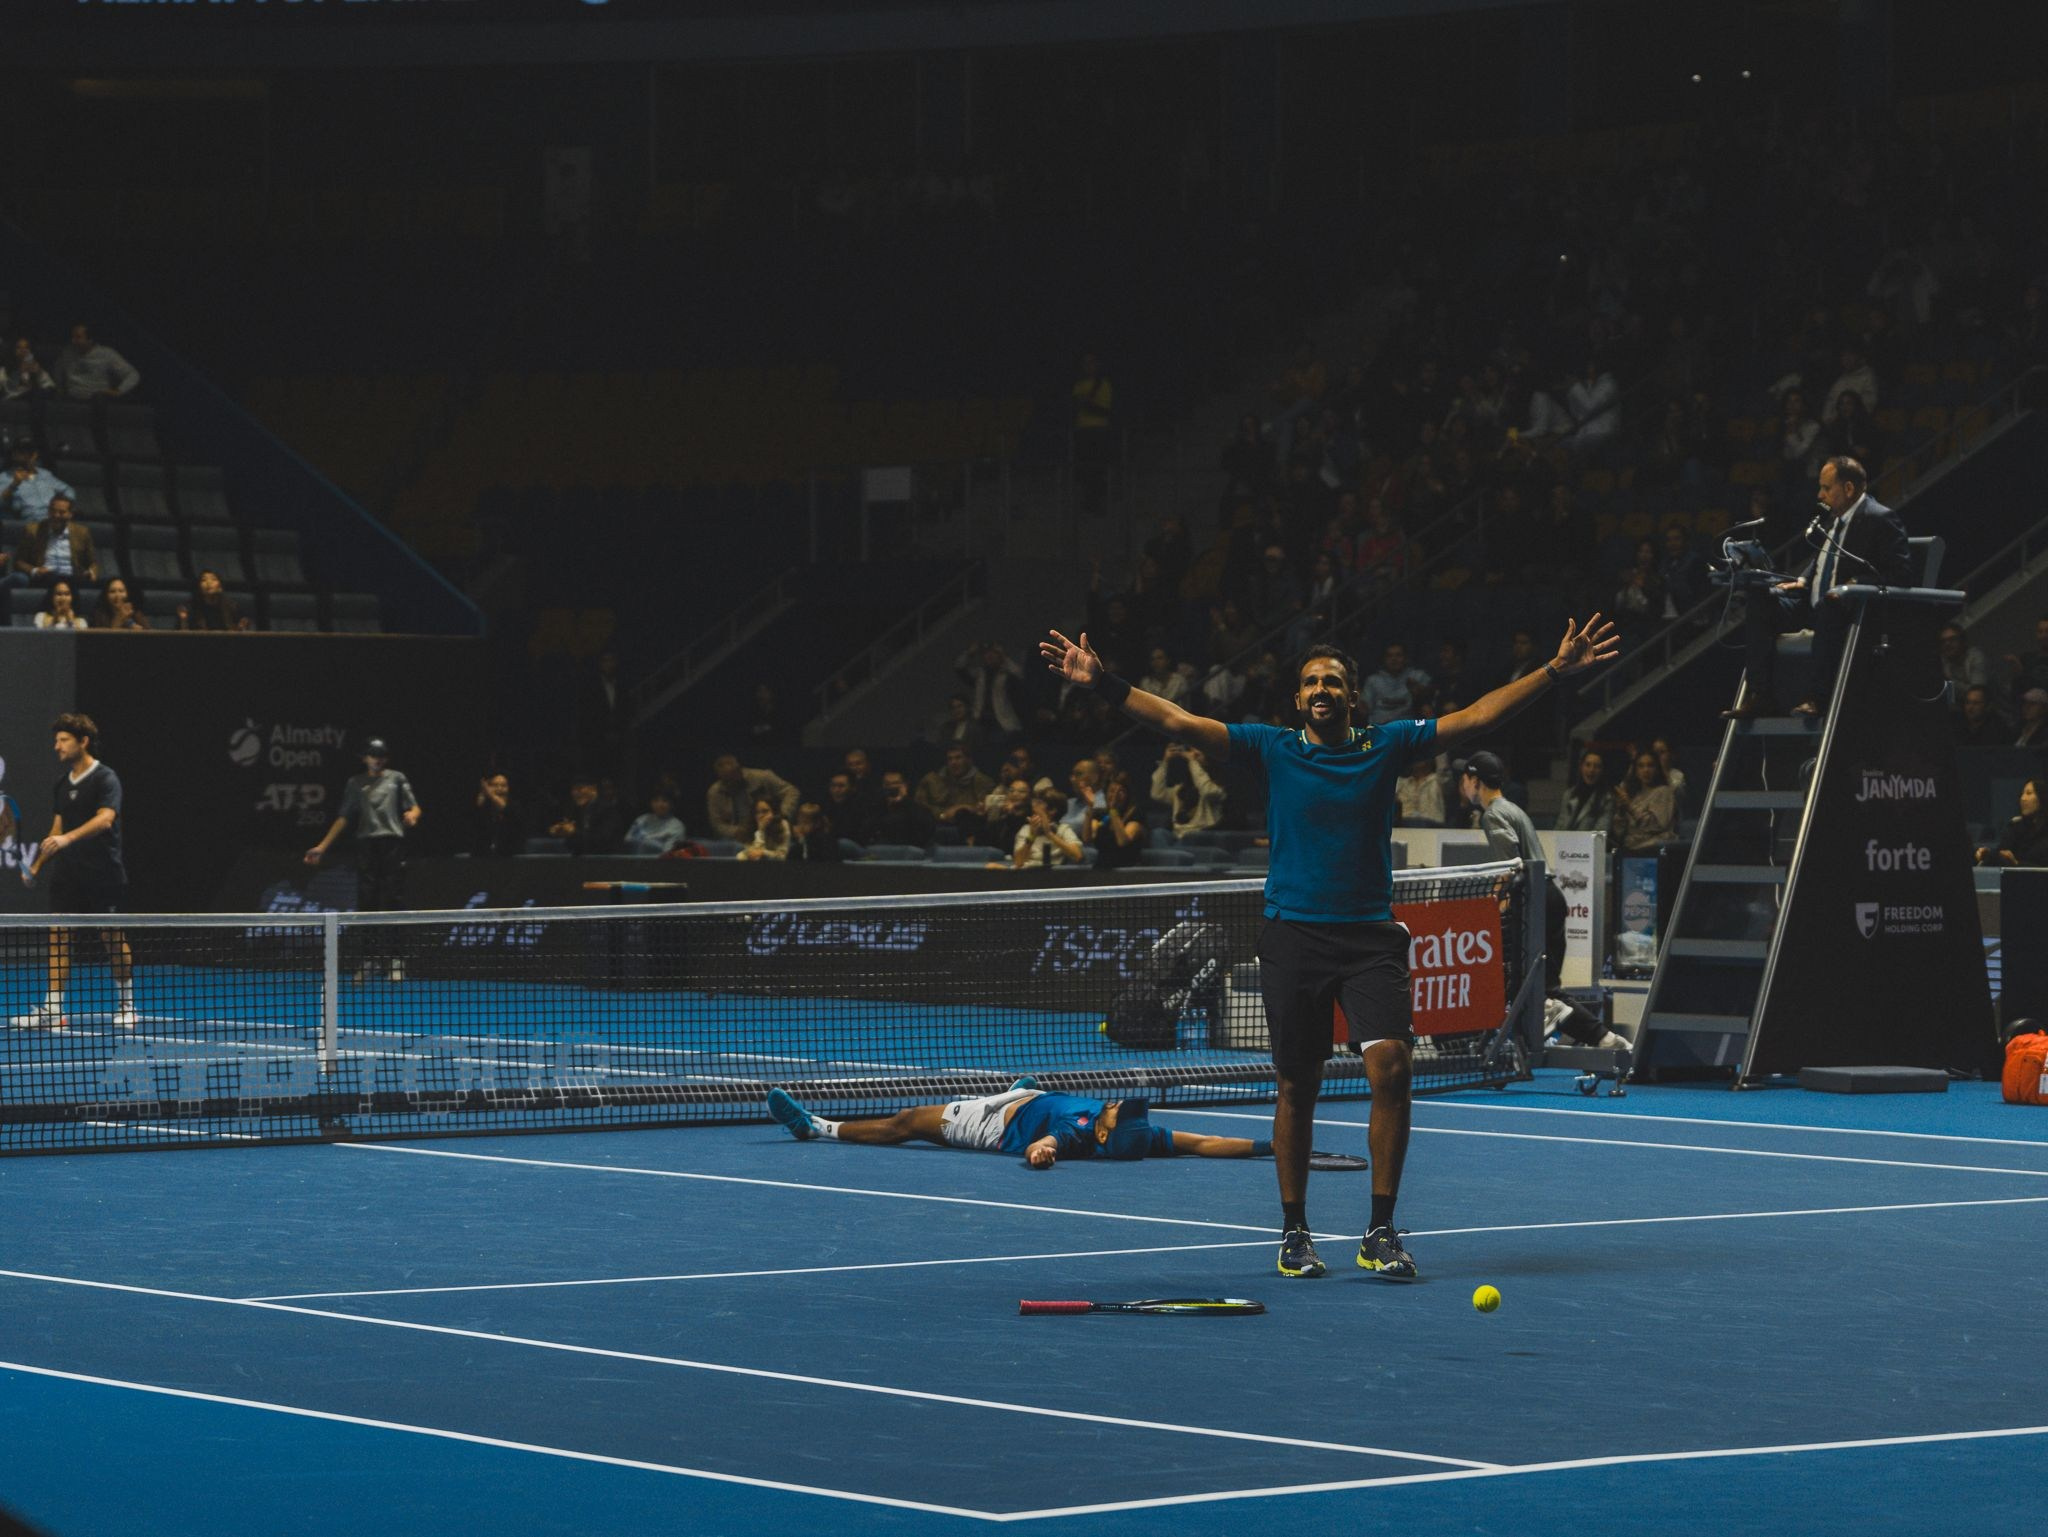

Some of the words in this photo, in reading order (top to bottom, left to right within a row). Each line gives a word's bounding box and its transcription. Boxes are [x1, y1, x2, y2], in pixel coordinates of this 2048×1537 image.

[271, 723, 346, 749] Almaty
[269, 745, 322, 769] Open
[255, 783, 326, 810] ATP
[1855, 774, 1937, 802] JANYMDA
[1864, 838, 1931, 871] forte
[1884, 906, 1944, 921] FREEDOM
[1884, 923, 1920, 934] HOLDING
[1408, 926, 1493, 970] rates
[1410, 972, 1471, 1013] ETTER
